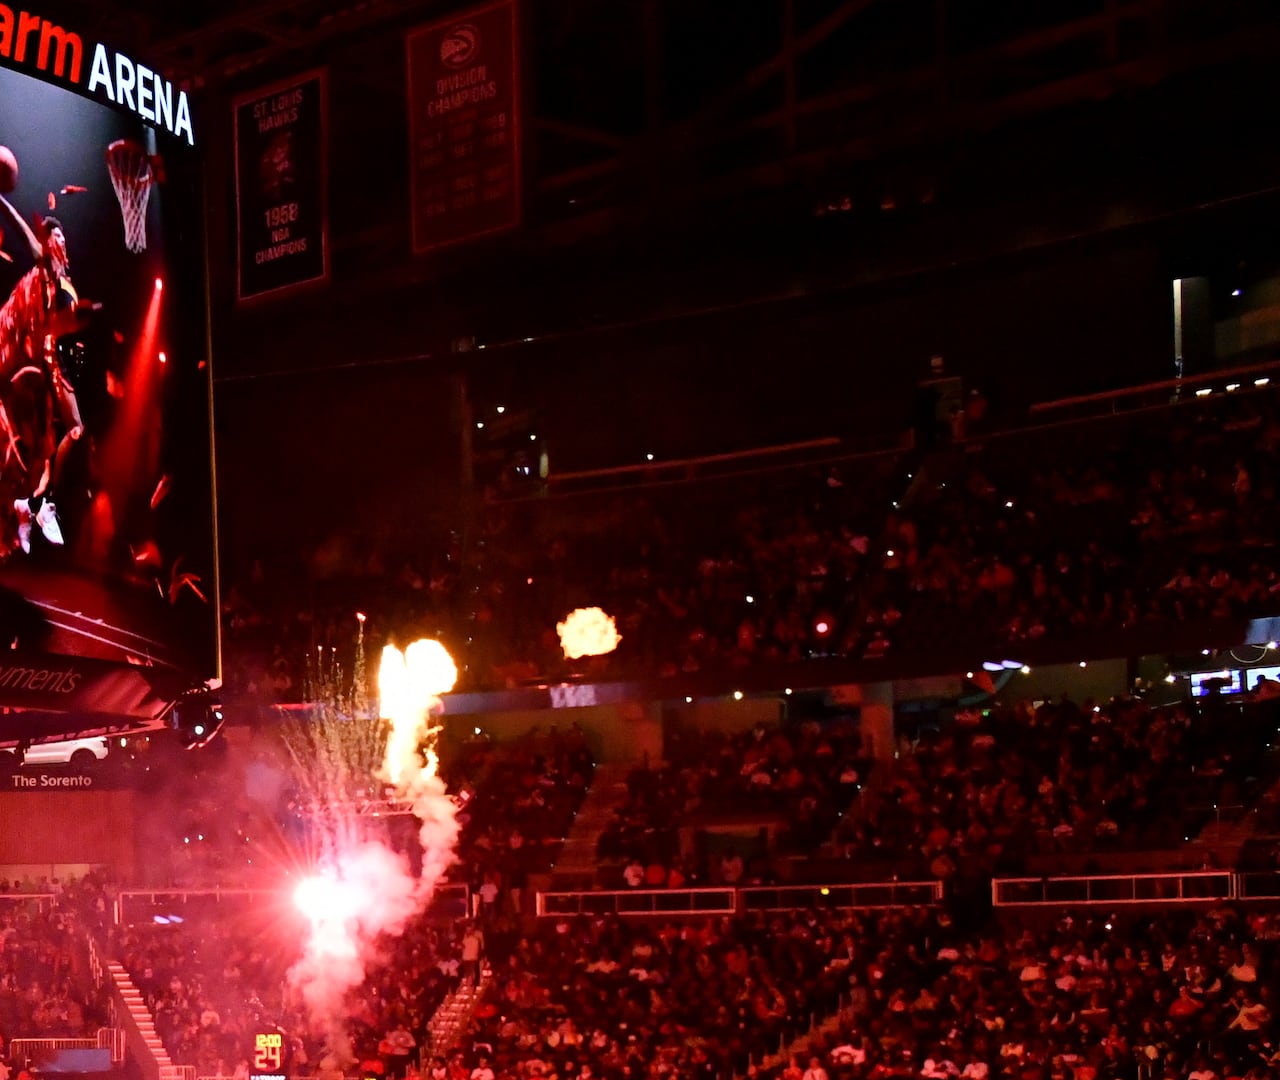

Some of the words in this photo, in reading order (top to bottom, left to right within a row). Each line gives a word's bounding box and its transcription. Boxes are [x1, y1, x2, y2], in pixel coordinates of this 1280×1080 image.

[436, 65, 487, 95] DIVISION
[88, 42, 196, 146] ARENA
[427, 80, 497, 118] CHAMPIONS
[258, 107, 299, 133] HAWKS
[265, 202, 299, 229] 1958
[255, 237, 308, 265] CHAMPIONS
[12, 775, 38, 787] The
[40, 775, 92, 787] Sorento
[255, 1047, 281, 1069] 24
